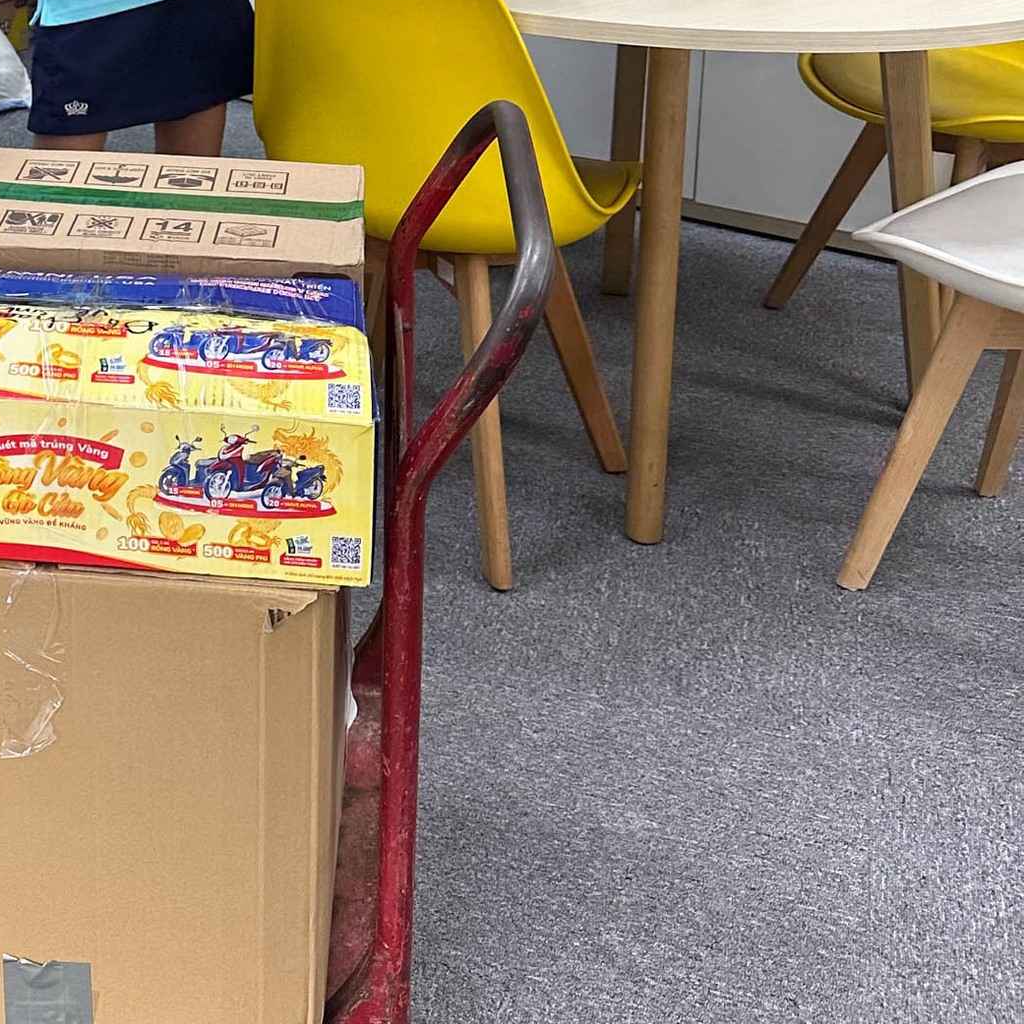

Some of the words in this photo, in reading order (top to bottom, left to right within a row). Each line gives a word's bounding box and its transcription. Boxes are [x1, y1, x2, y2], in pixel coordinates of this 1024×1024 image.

[158, 220, 193, 233] 14
[8, 363, 42, 376] 500
[39, 439, 74, 452] trúng
[77, 443, 110, 460] Vàng
[34, 449, 129, 503] Vàng
[22, 517, 45, 527] VÀNG
[59, 520, 88, 532] KHÁNG
[118, 536, 150, 551] 100
[203, 544, 234, 558] 500
